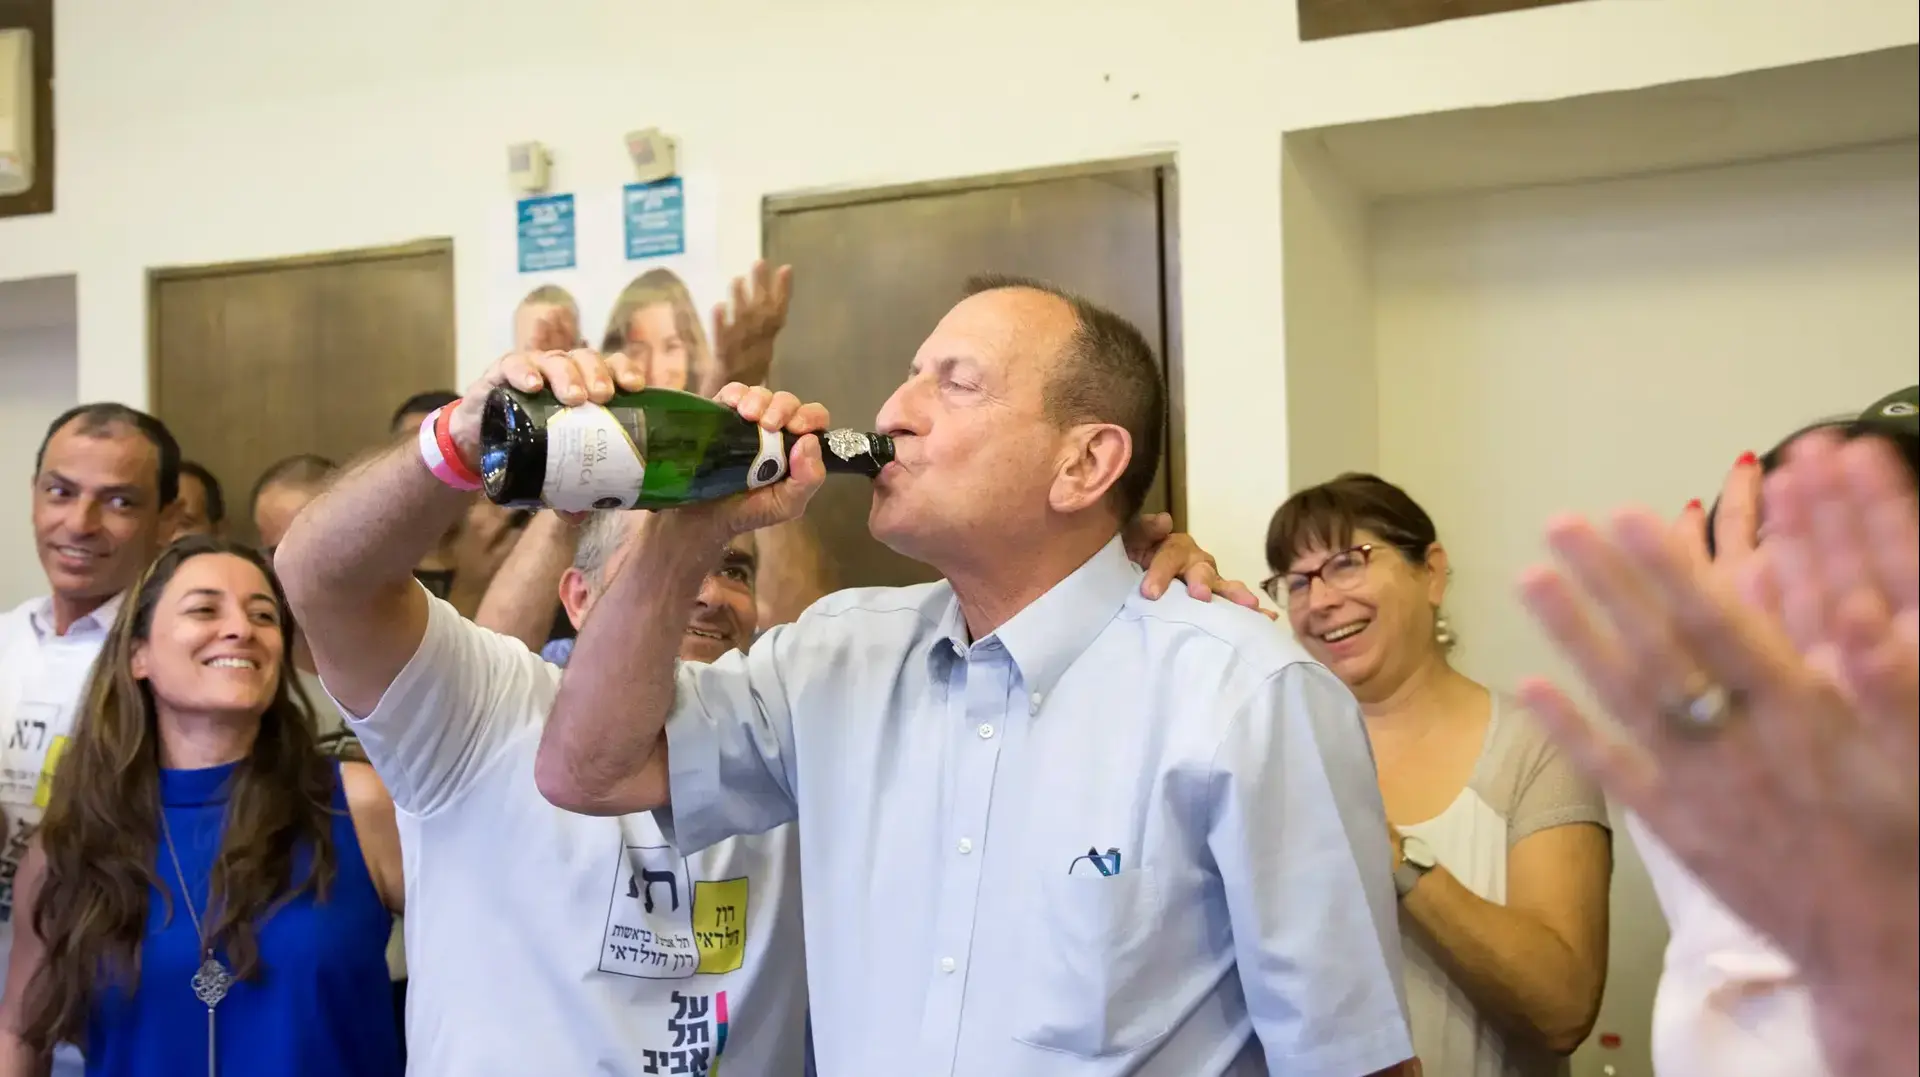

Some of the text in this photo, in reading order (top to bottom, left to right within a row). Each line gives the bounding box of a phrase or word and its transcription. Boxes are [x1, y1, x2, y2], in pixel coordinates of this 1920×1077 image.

[579, 429, 595, 486] ERICA
[597, 428, 607, 463] CAVA
[716, 905, 735, 927] רון
[612, 924, 652, 943] בראשות
[696, 926, 740, 949] חלדאי
[609, 943, 694, 972] רון חולדאי
[671, 990, 709, 1019] על
[668, 1018, 710, 1047] תל
[643, 1047, 710, 1074] אביב
